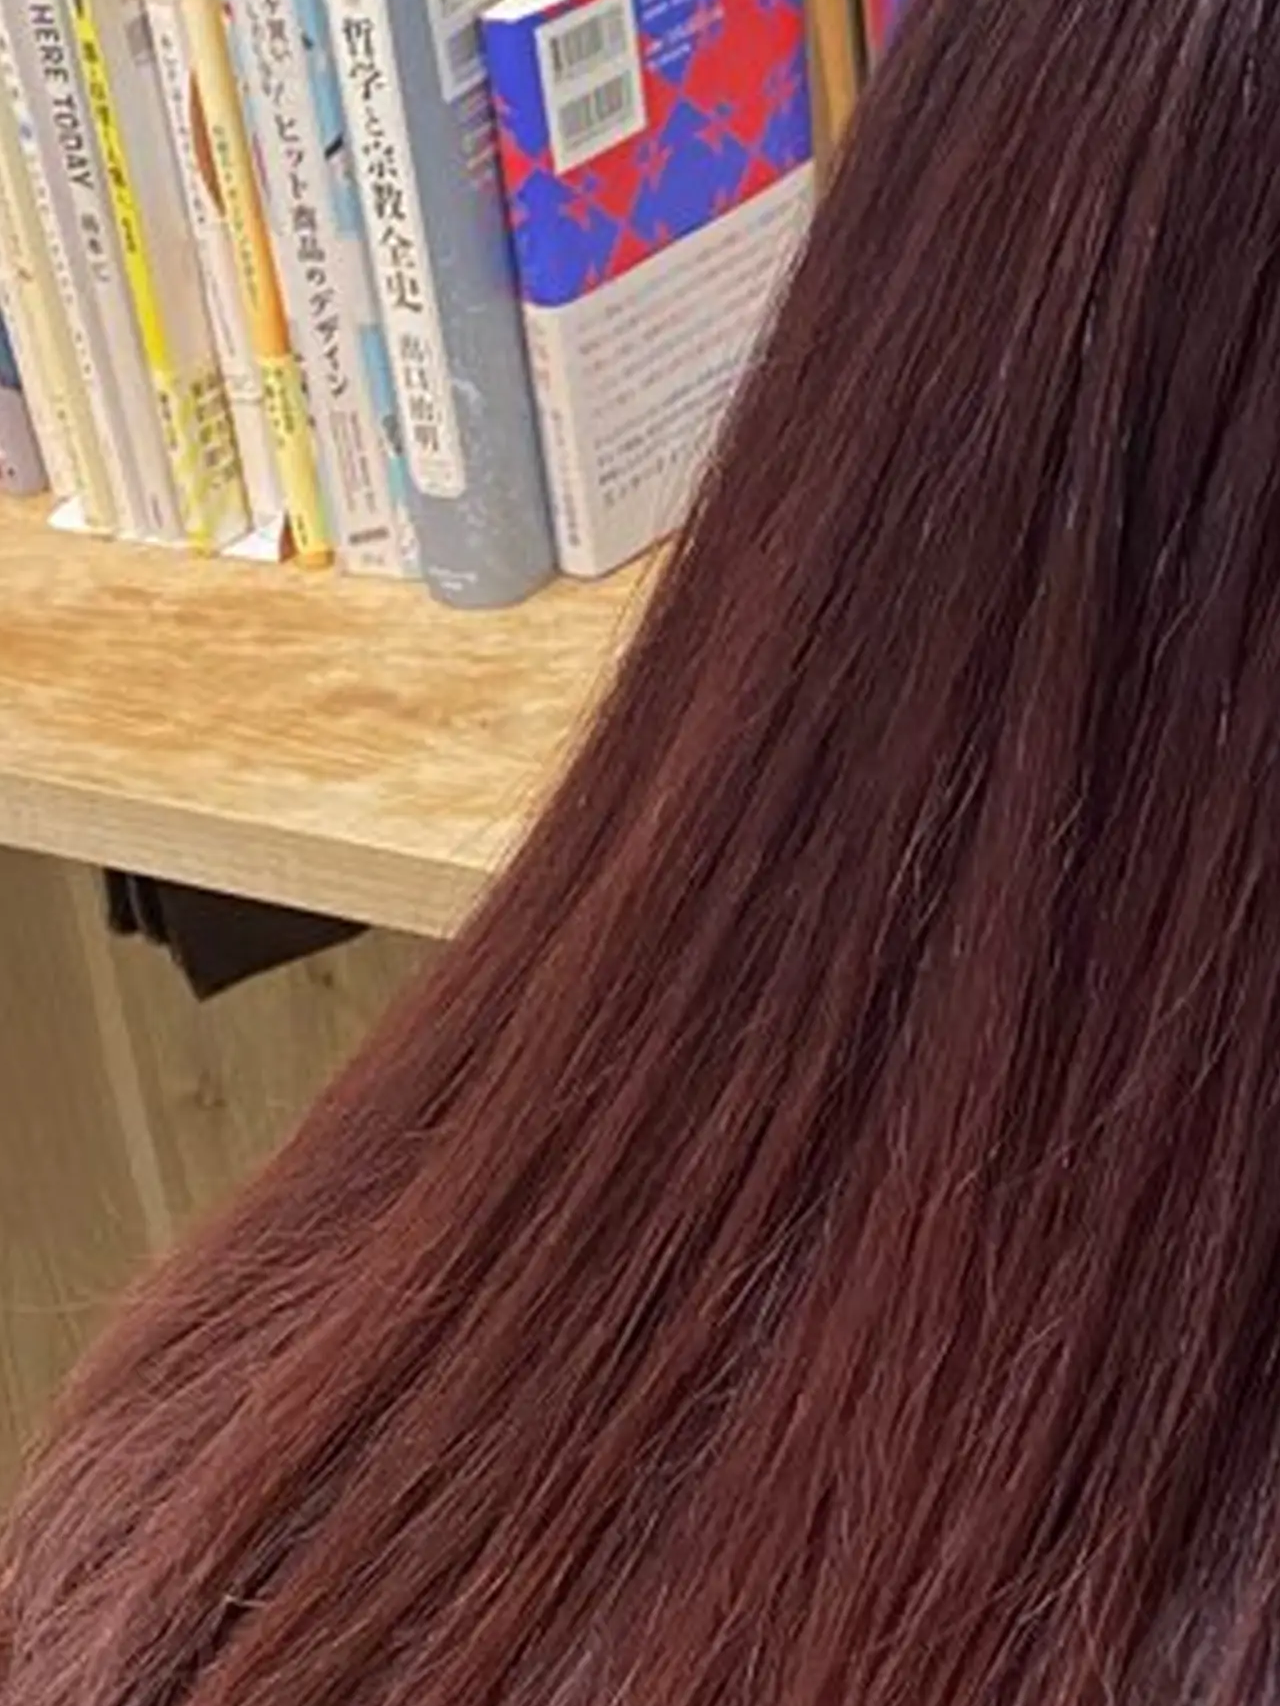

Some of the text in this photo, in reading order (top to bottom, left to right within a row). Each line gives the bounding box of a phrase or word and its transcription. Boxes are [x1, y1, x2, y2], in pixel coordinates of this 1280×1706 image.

[29, 3, 94, 190] HERE TODAY
[341, 17, 424, 314] 哲学と宗教全史
[274, 112, 349, 399] ヒット商品のデザイン
